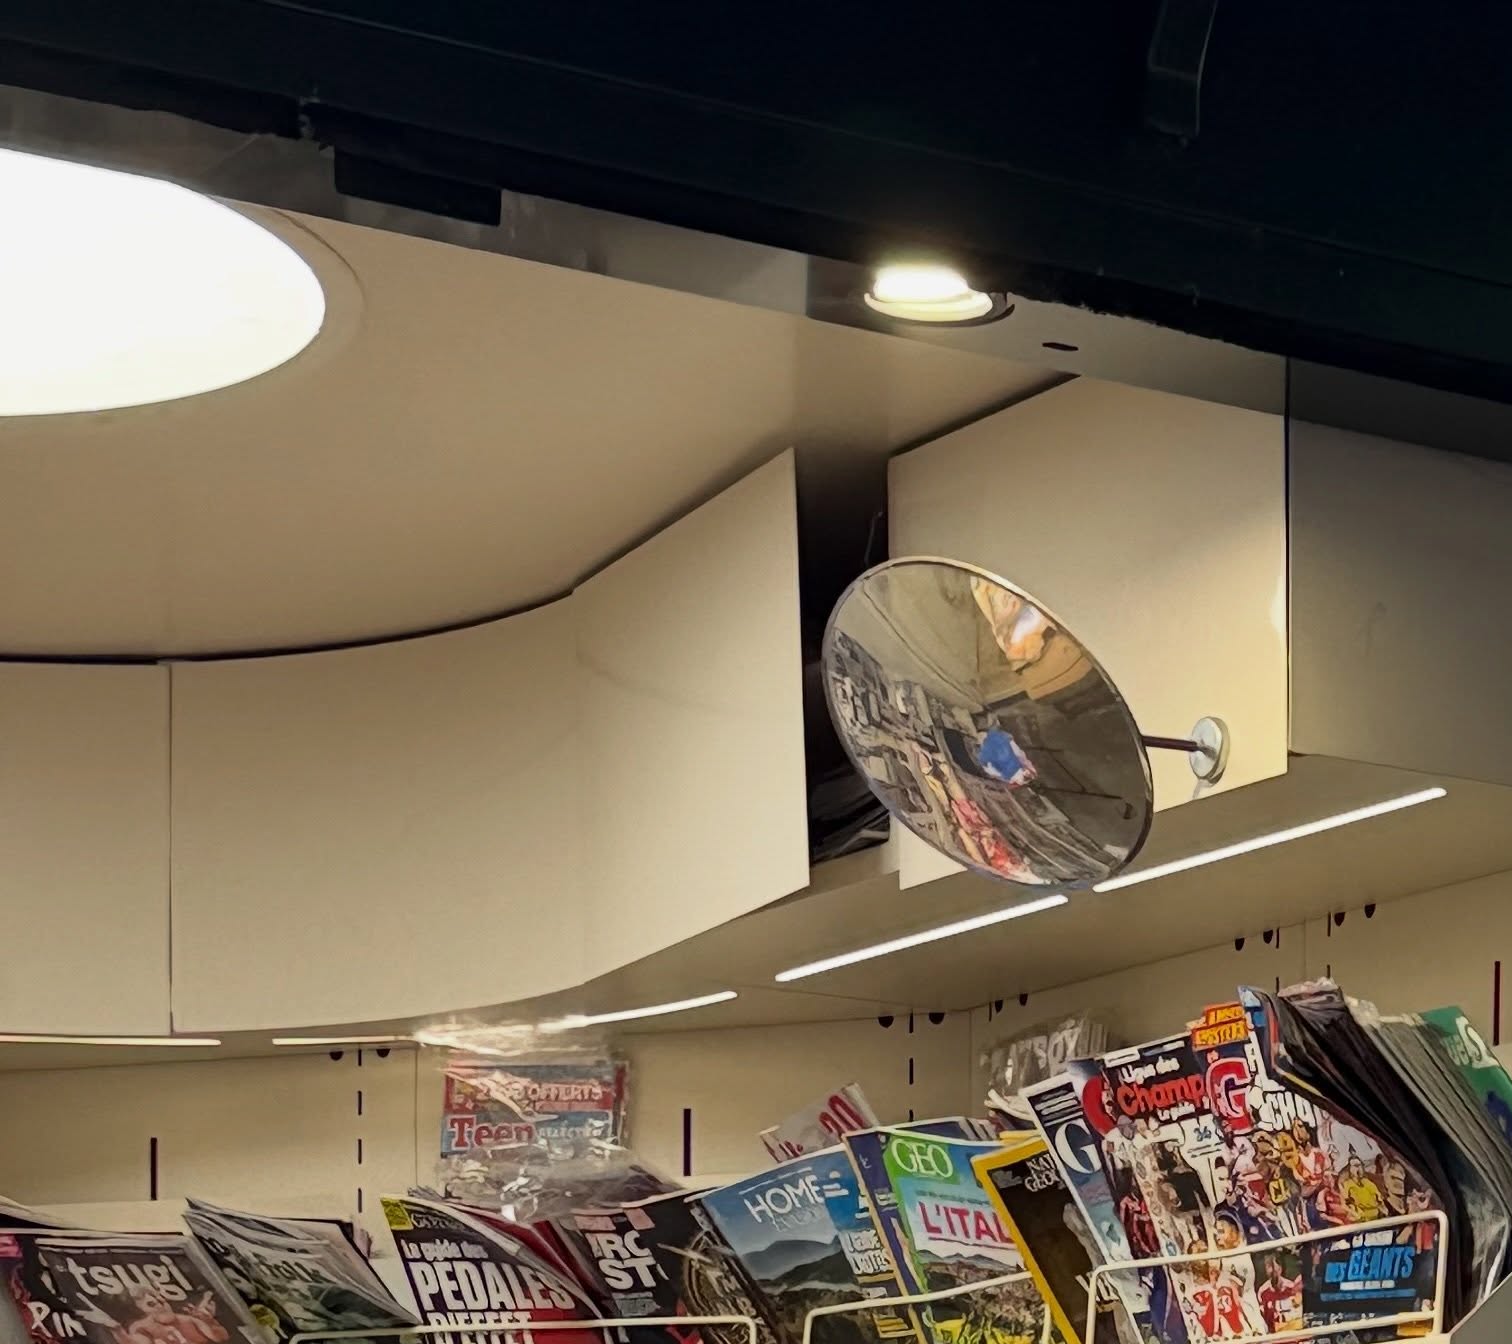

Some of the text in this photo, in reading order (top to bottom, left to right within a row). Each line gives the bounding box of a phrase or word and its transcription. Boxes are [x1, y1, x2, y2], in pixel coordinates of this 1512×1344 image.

[890, 1138, 955, 1183] GEO
[744, 1173, 827, 1226] HOME
[918, 1200, 1012, 1246] L'ITAL
[70, 1252, 194, 1300] tsugi
